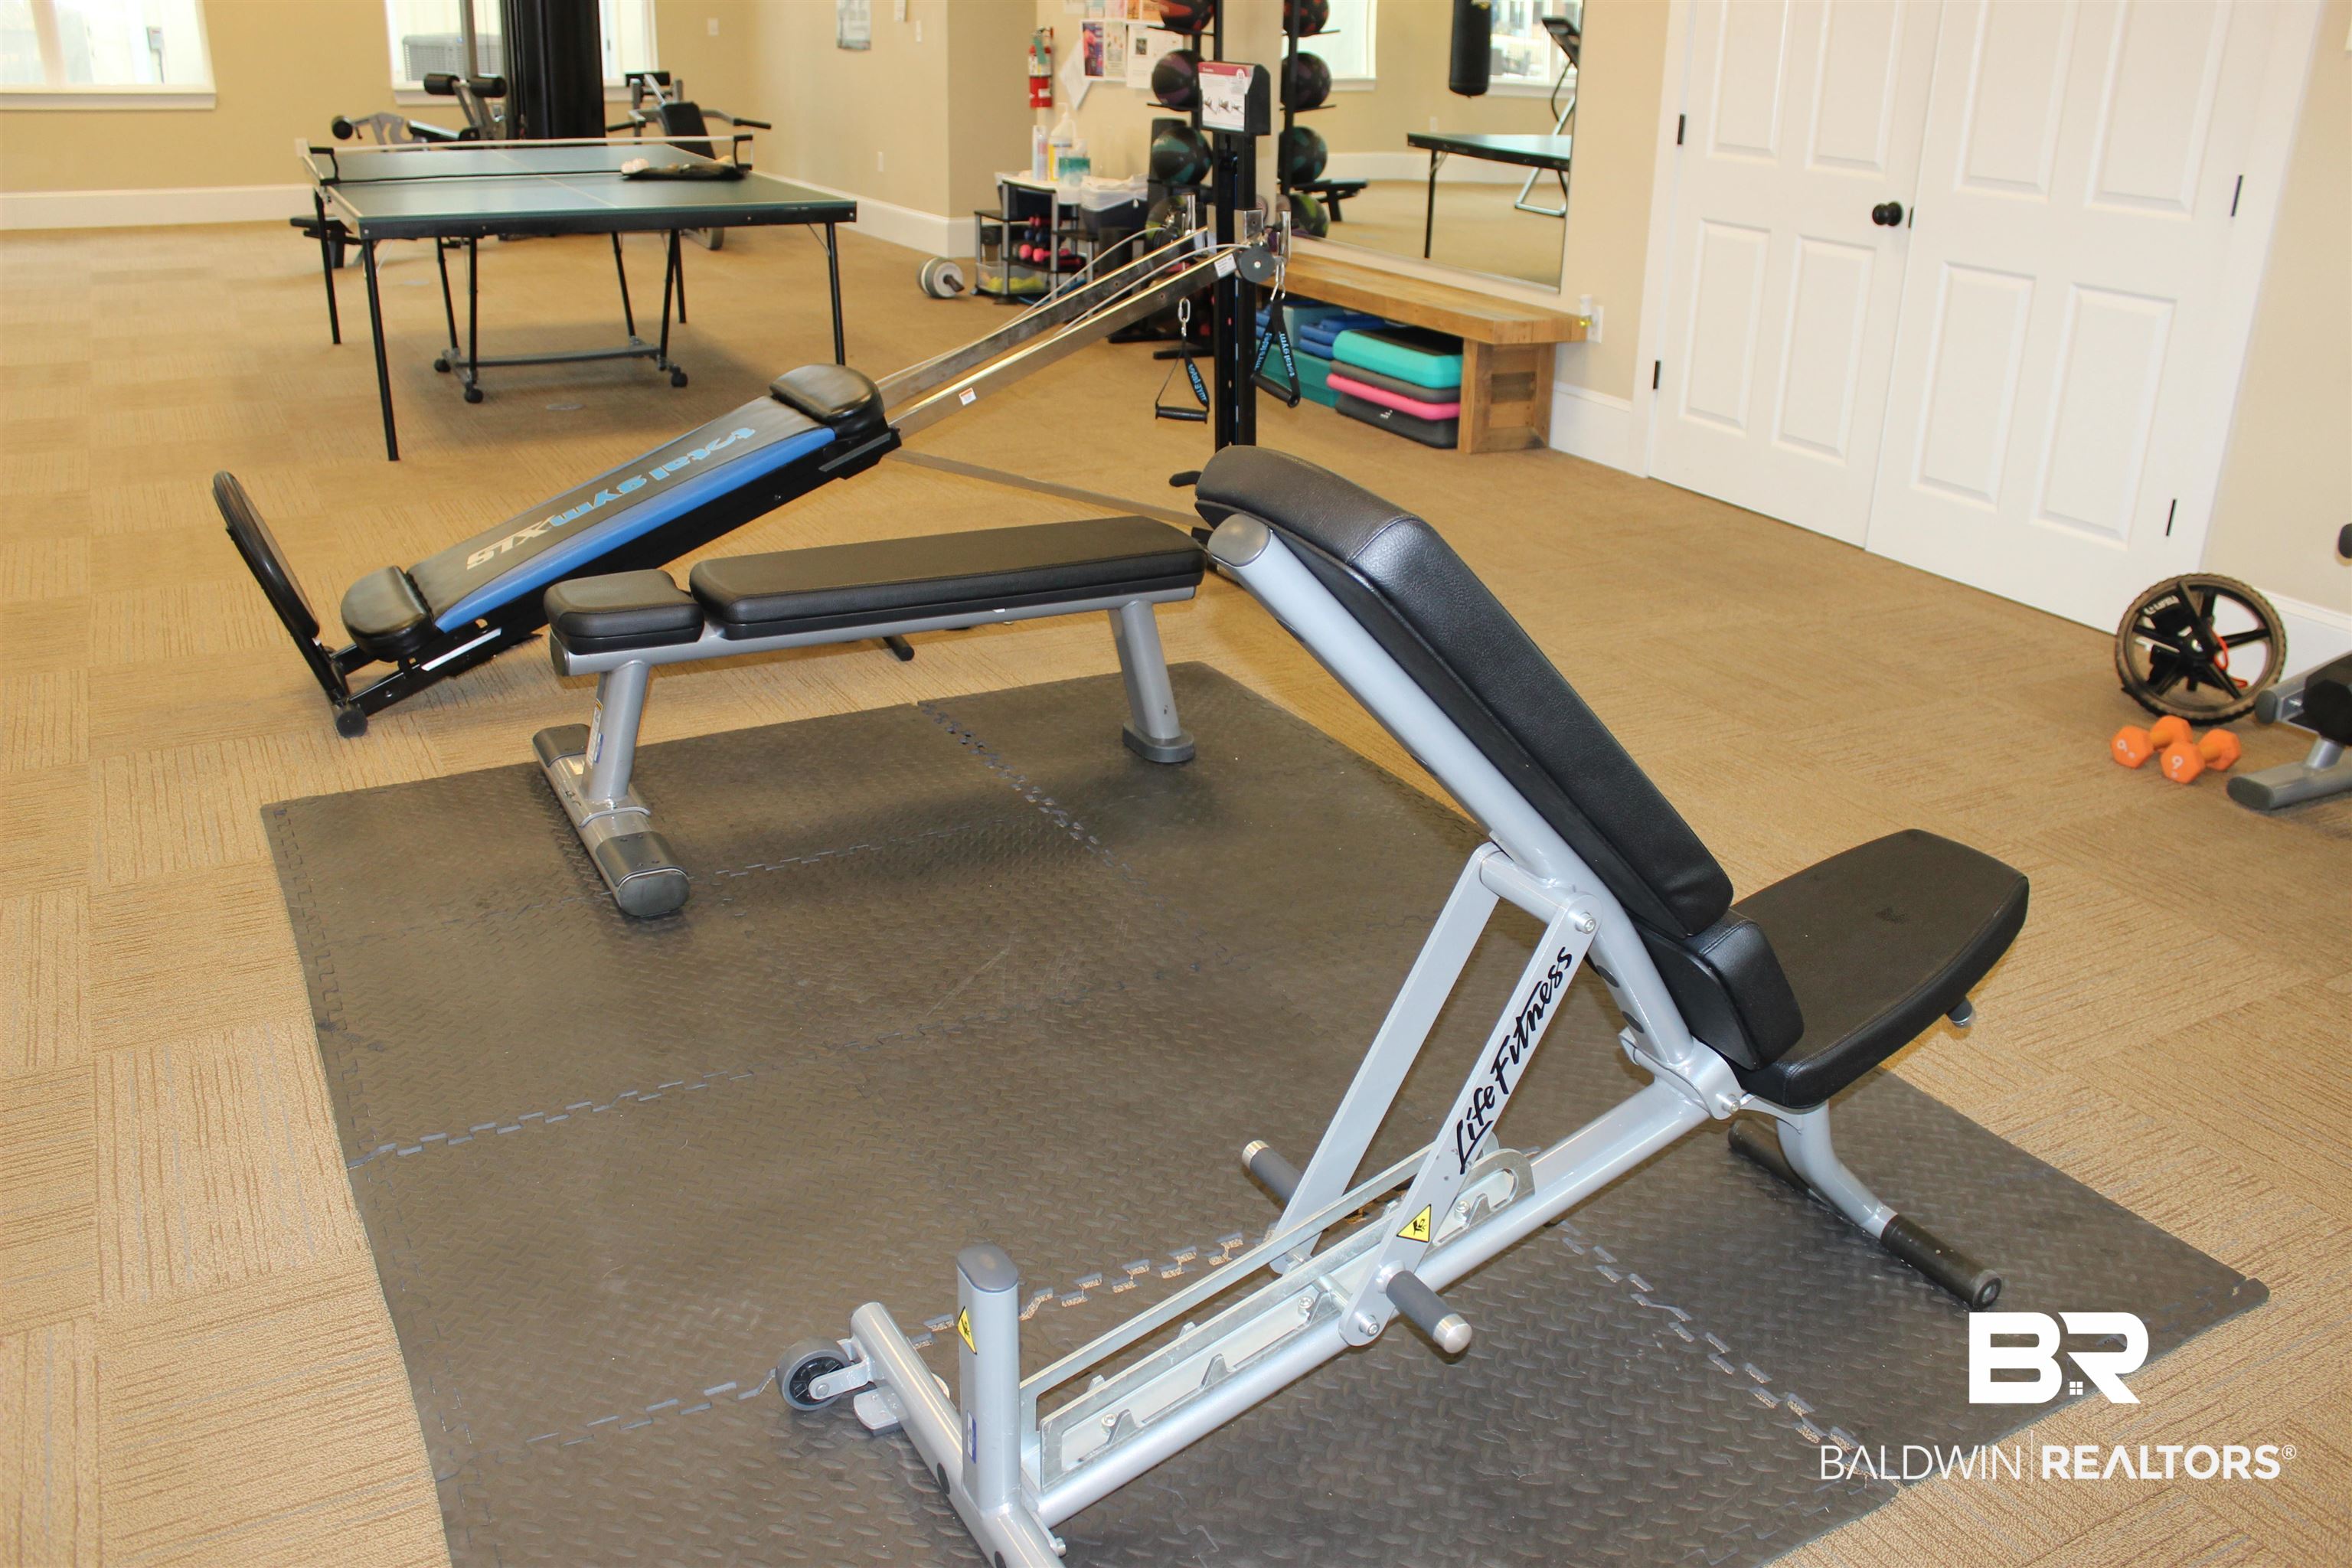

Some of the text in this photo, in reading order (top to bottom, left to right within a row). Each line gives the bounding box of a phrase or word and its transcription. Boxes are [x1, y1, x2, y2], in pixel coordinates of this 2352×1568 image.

[466, 426, 756, 570] total gym XLS
[1456, 946, 1573, 1175] Life Fitness
